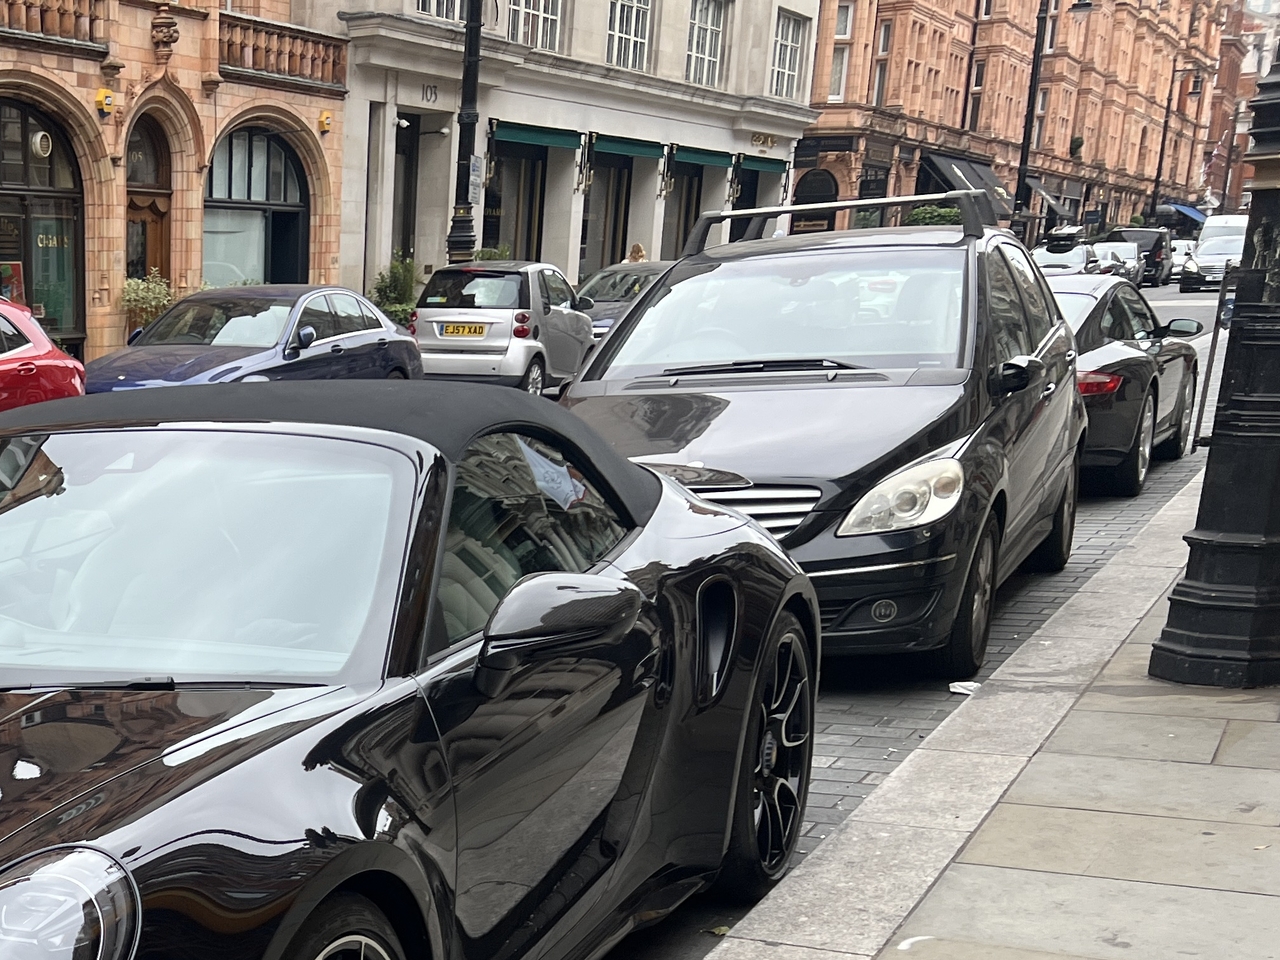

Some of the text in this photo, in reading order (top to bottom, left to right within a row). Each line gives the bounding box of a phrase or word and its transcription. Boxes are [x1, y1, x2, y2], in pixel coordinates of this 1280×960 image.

[421, 84, 438, 103] 103
[445, 324, 484, 335] EJ57 XAD
